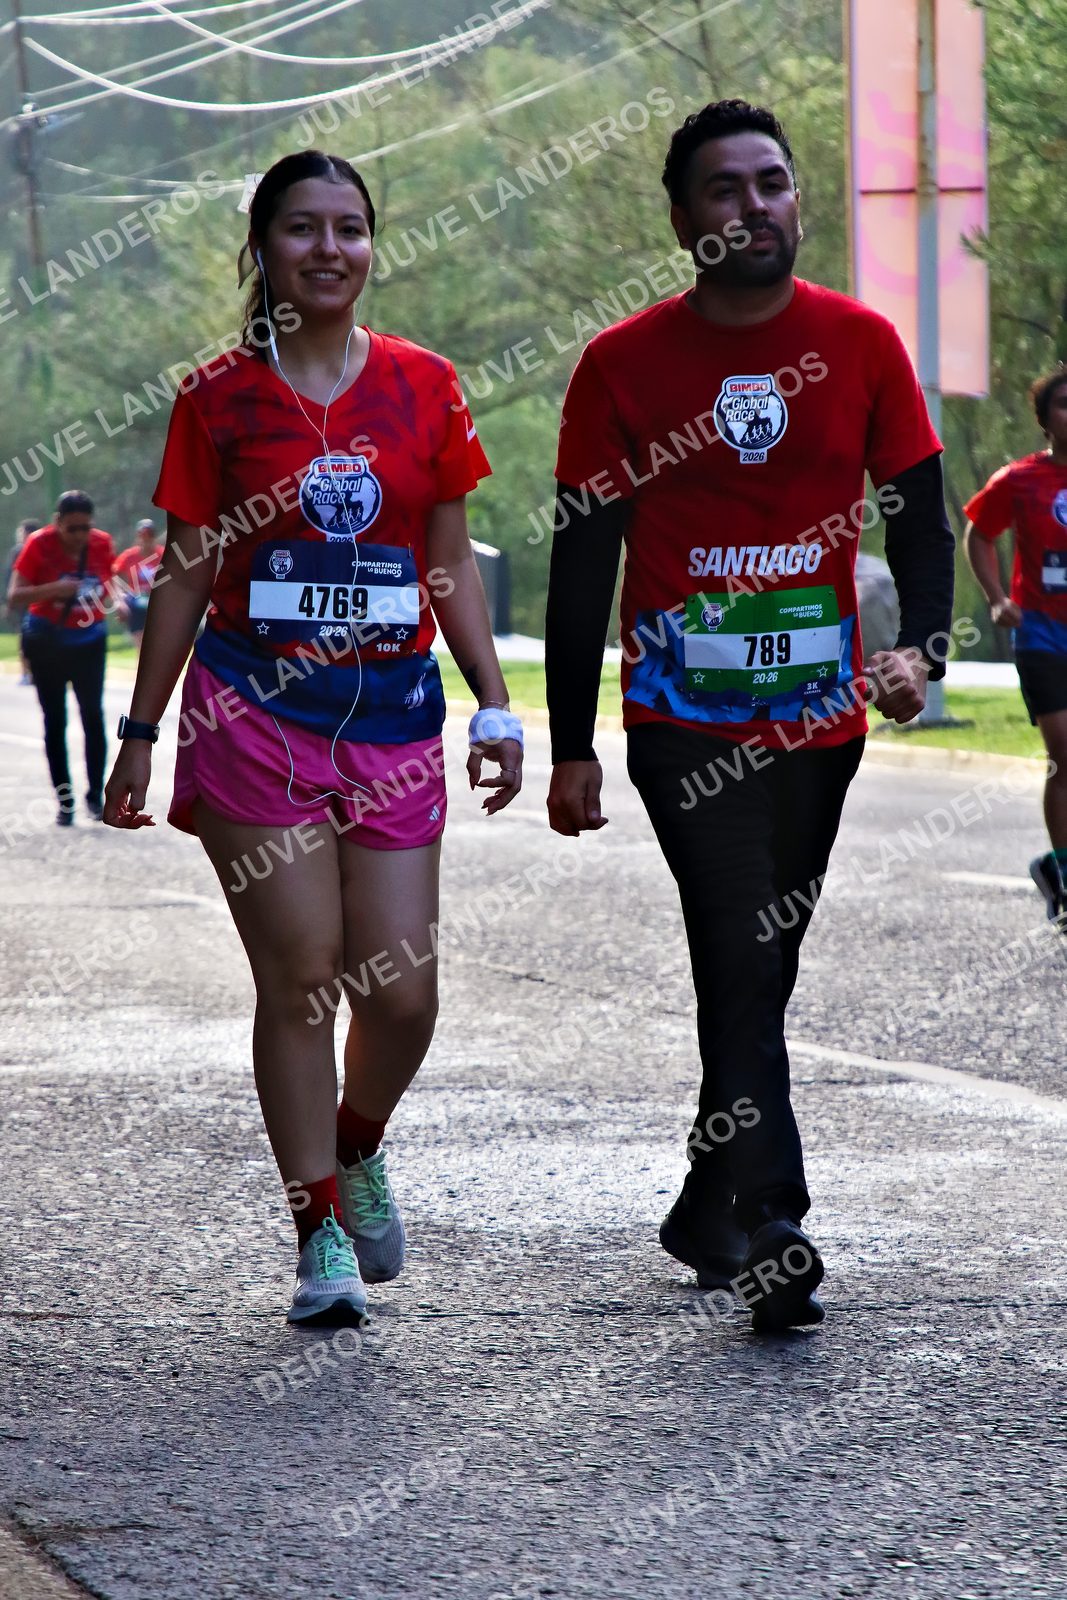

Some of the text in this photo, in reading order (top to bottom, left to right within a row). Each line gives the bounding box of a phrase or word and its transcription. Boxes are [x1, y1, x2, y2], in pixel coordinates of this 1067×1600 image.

[730, 383, 768, 392] BIMBO
[732, 396, 769, 410] Global
[726, 409, 755, 422] Race
[742, 452, 764, 462] 2026
[318, 464, 361, 472] BMBO
[312, 492, 346, 504] Race
[352, 561, 402, 569] COMPARTIMOS
[688, 543, 822, 577] SANTIAGO
[298, 586, 368, 620] 4769
[780, 604, 822, 614] COMPARTIMOS
[376, 642, 400, 652] 10K
[744, 632, 790, 667] 789
